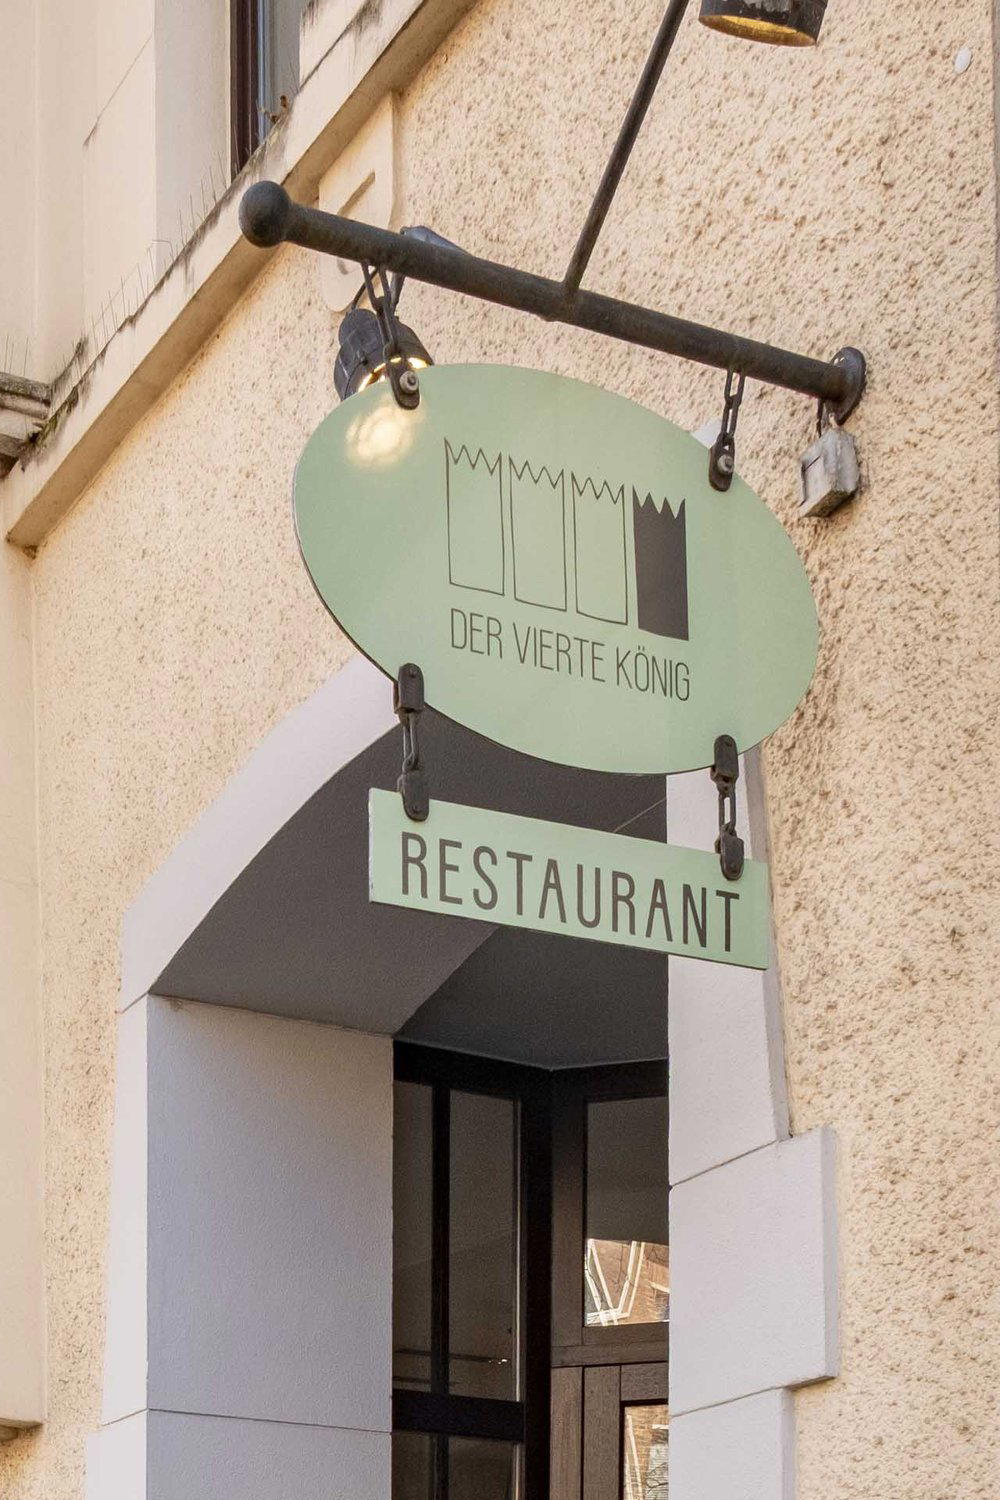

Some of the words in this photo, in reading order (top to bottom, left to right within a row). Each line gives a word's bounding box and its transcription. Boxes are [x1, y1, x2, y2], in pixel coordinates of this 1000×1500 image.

[450, 607, 503, 659] DER
[512, 621, 606, 684] VIERTE
[615, 645, 691, 702] KÖNIG
[401, 831, 741, 953] RESTAURANT
